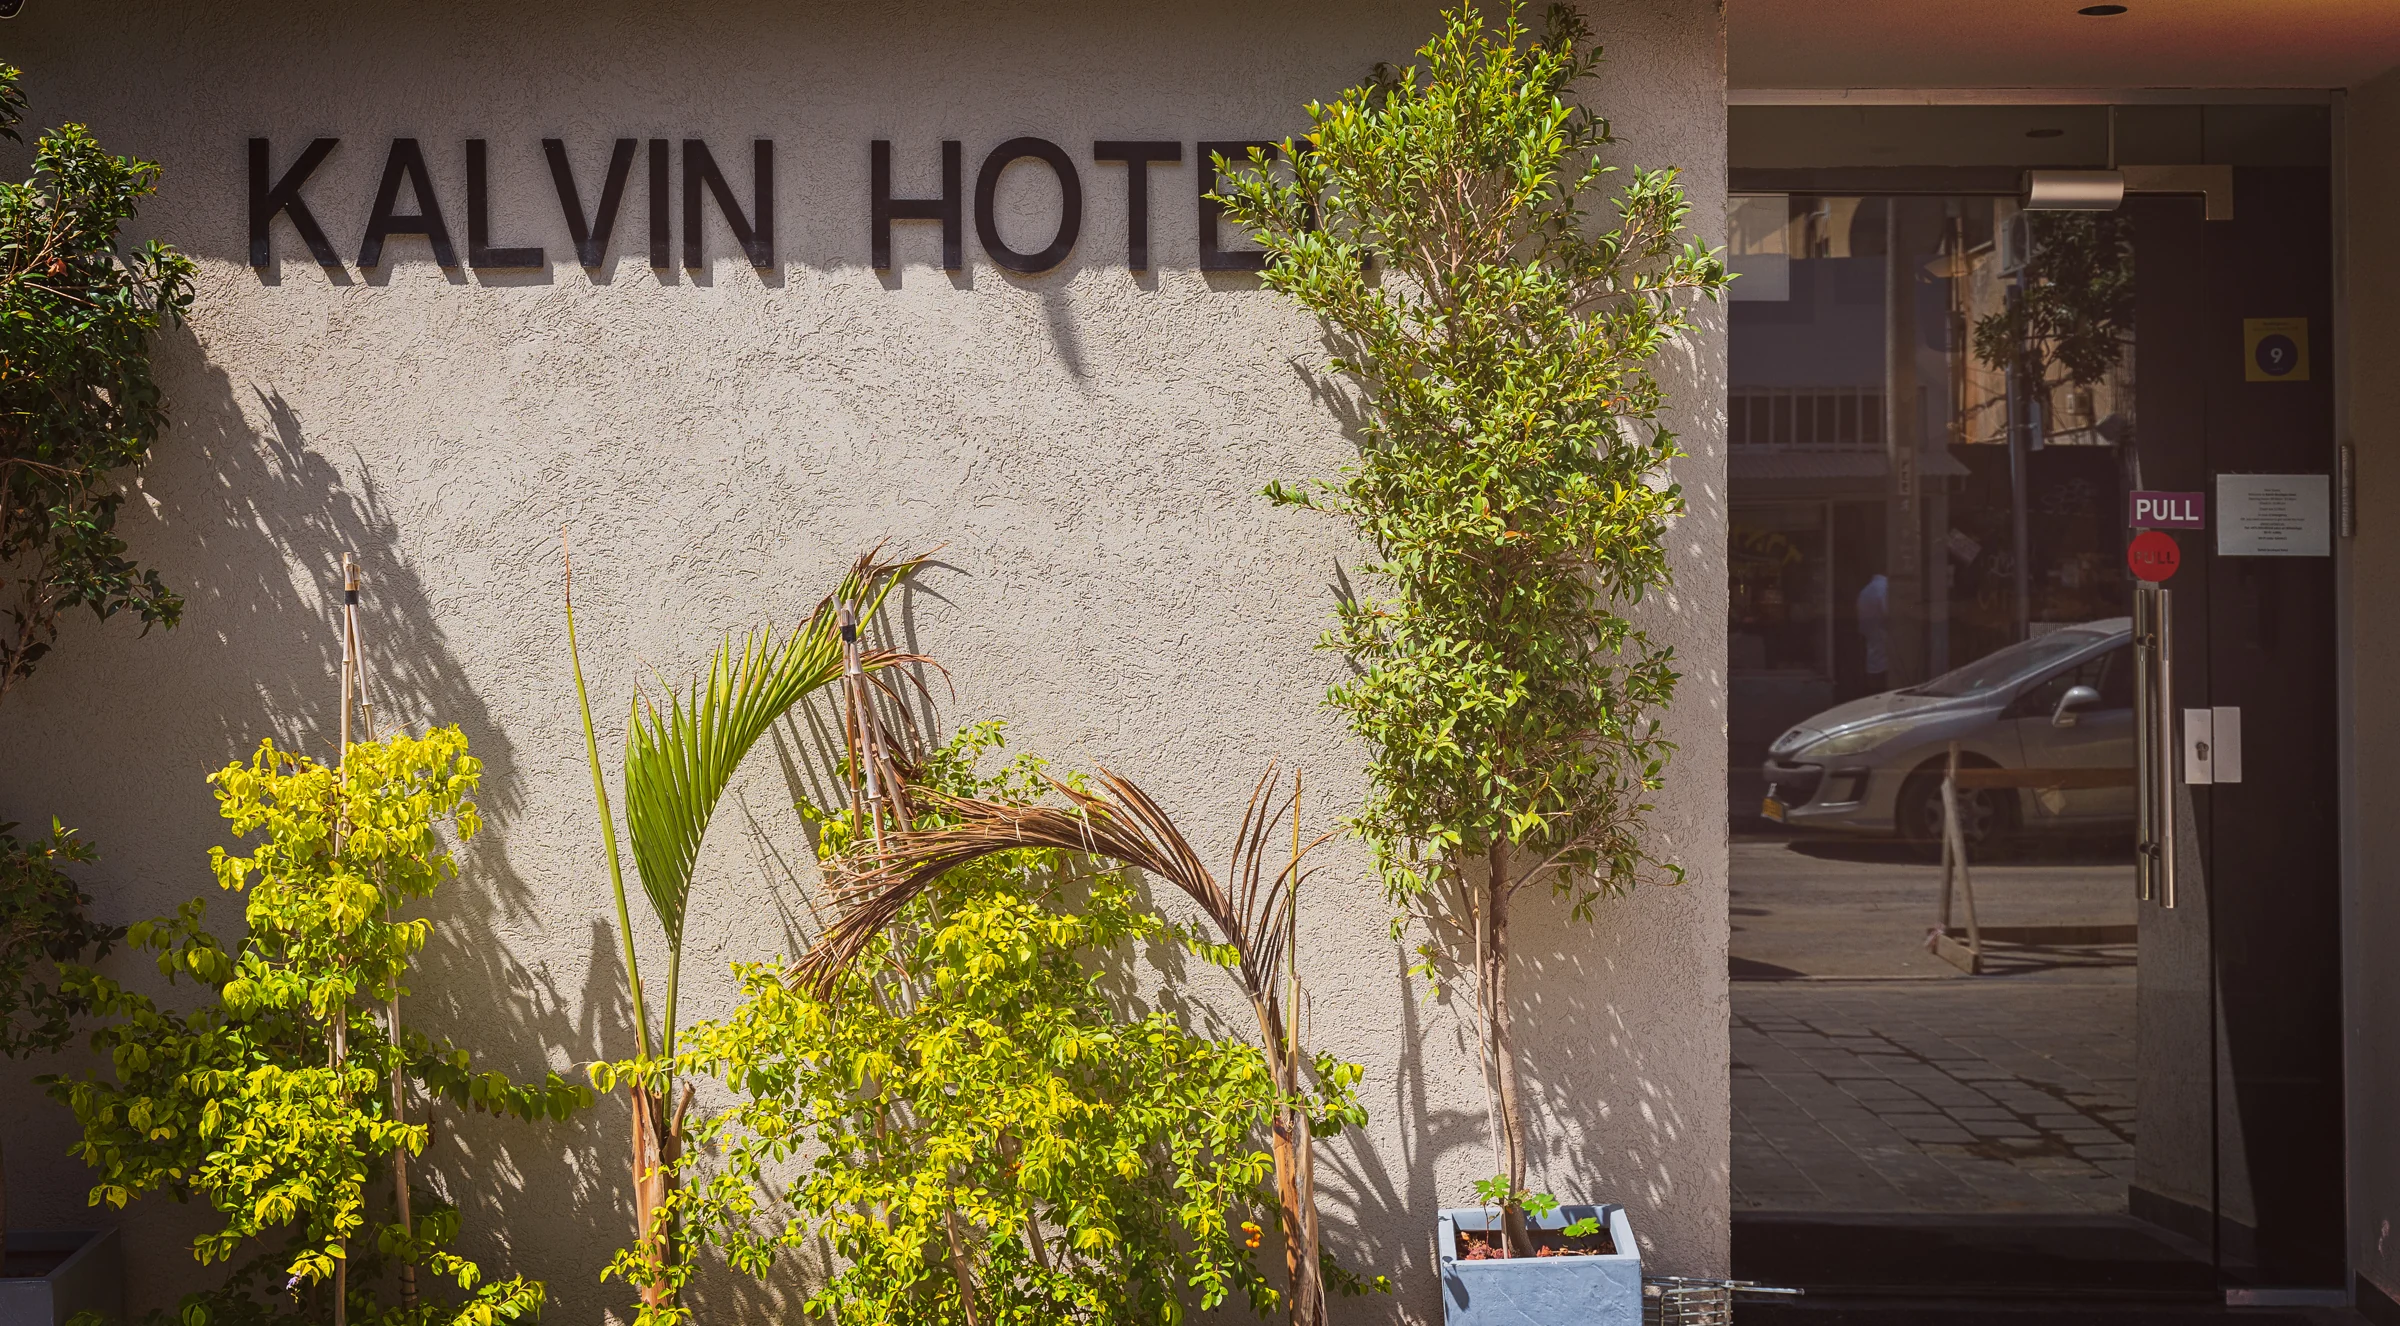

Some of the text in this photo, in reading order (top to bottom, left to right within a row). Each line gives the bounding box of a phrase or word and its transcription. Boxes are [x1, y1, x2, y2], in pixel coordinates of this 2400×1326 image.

[249, 138, 774, 269] KALVIN
[2270, 347, 2283, 363] 9
[2136, 499, 2199, 521] PULL
[2134, 551, 2175, 565] PULL
